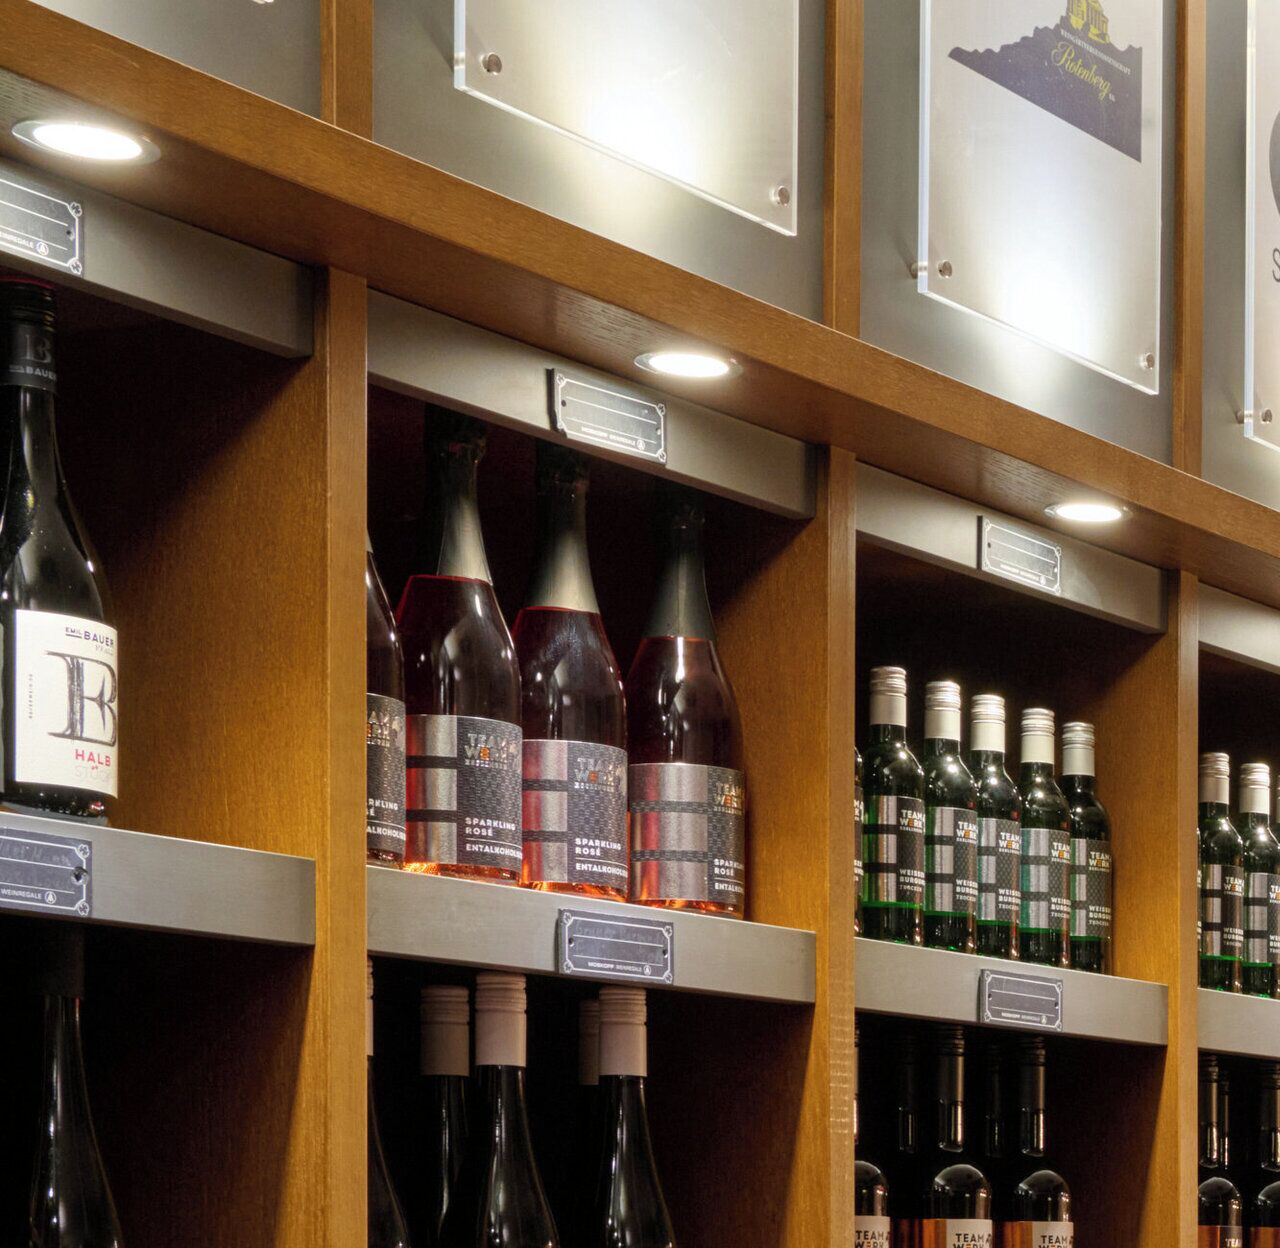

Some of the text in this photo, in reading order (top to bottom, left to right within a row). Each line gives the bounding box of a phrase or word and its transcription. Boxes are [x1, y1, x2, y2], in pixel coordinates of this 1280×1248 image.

[1051, 41, 1112, 101] Rotenberg
[84, 631, 114, 647] BAUER
[75, 749, 111, 767] HALB
[465, 817, 516, 831] SPARKLING
[465, 826, 494, 837] ROSÉ
[575, 837, 621, 851] SPARKLING
[575, 847, 601, 856] ROSÉ
[714, 867, 734, 876] ROSÉ
[855, 1230, 884, 1240] TEAM
[956, 1233, 984, 1242] TEAM
[1041, 1235, 1068, 1244] TEAM
